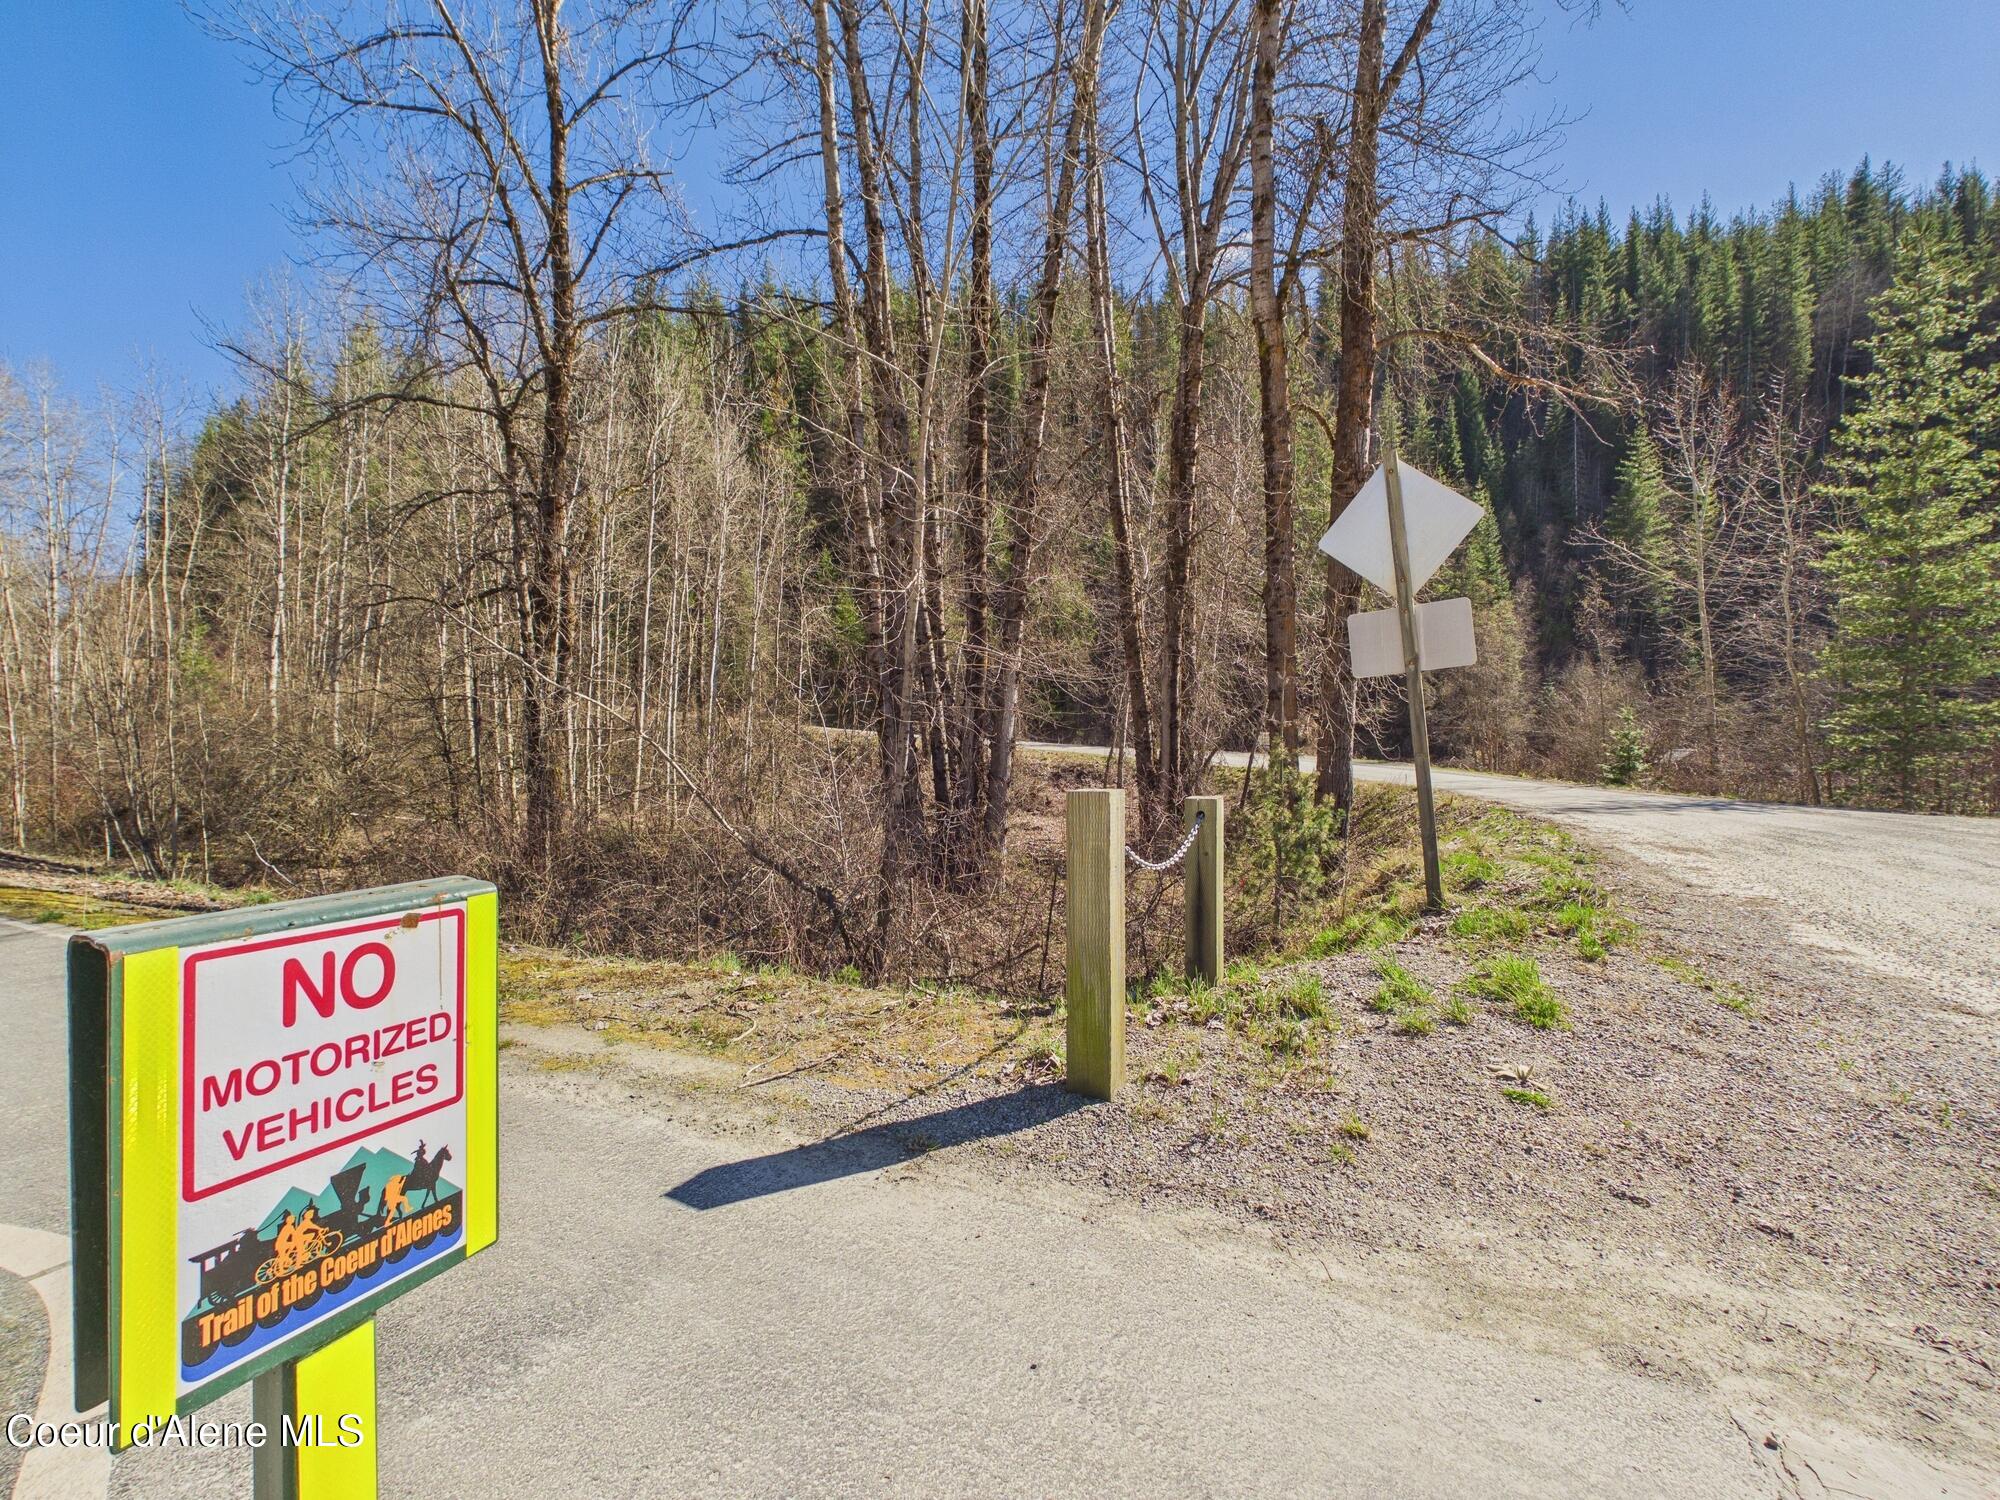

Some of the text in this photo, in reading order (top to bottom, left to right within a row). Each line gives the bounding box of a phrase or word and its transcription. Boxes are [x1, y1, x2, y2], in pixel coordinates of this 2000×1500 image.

[282, 942, 396, 1028] NO
[202, 1012, 452, 1112] MOTORIZED
[222, 1063, 439, 1161] VEHICLES
[198, 1204, 452, 1348] Trail of the Coeur d'Alenes
